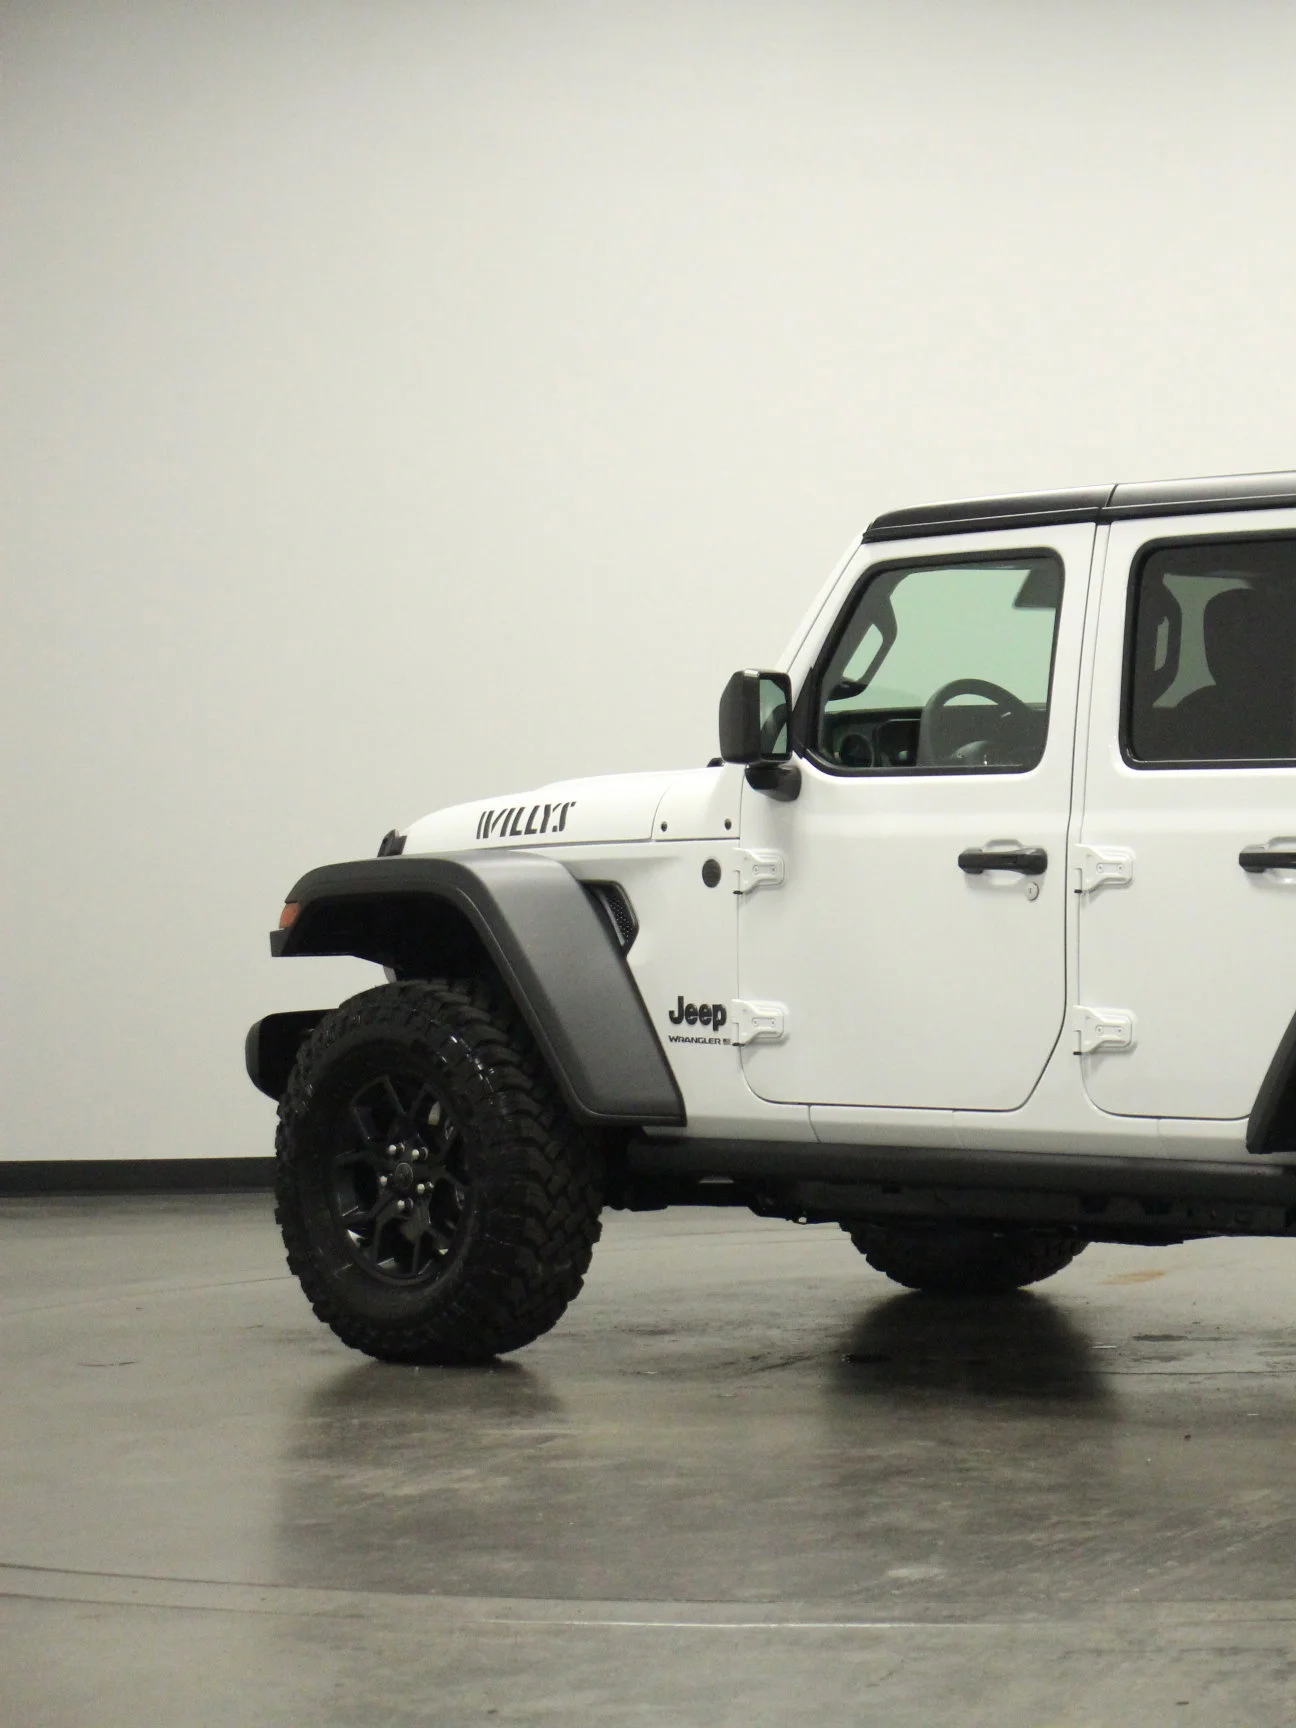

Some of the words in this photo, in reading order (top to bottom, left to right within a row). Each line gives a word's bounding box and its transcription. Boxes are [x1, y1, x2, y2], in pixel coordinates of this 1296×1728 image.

[476, 801, 577, 839] WILLYS
[668, 995, 727, 1031] Jeep
[668, 1035, 721, 1045] WRANGLER
